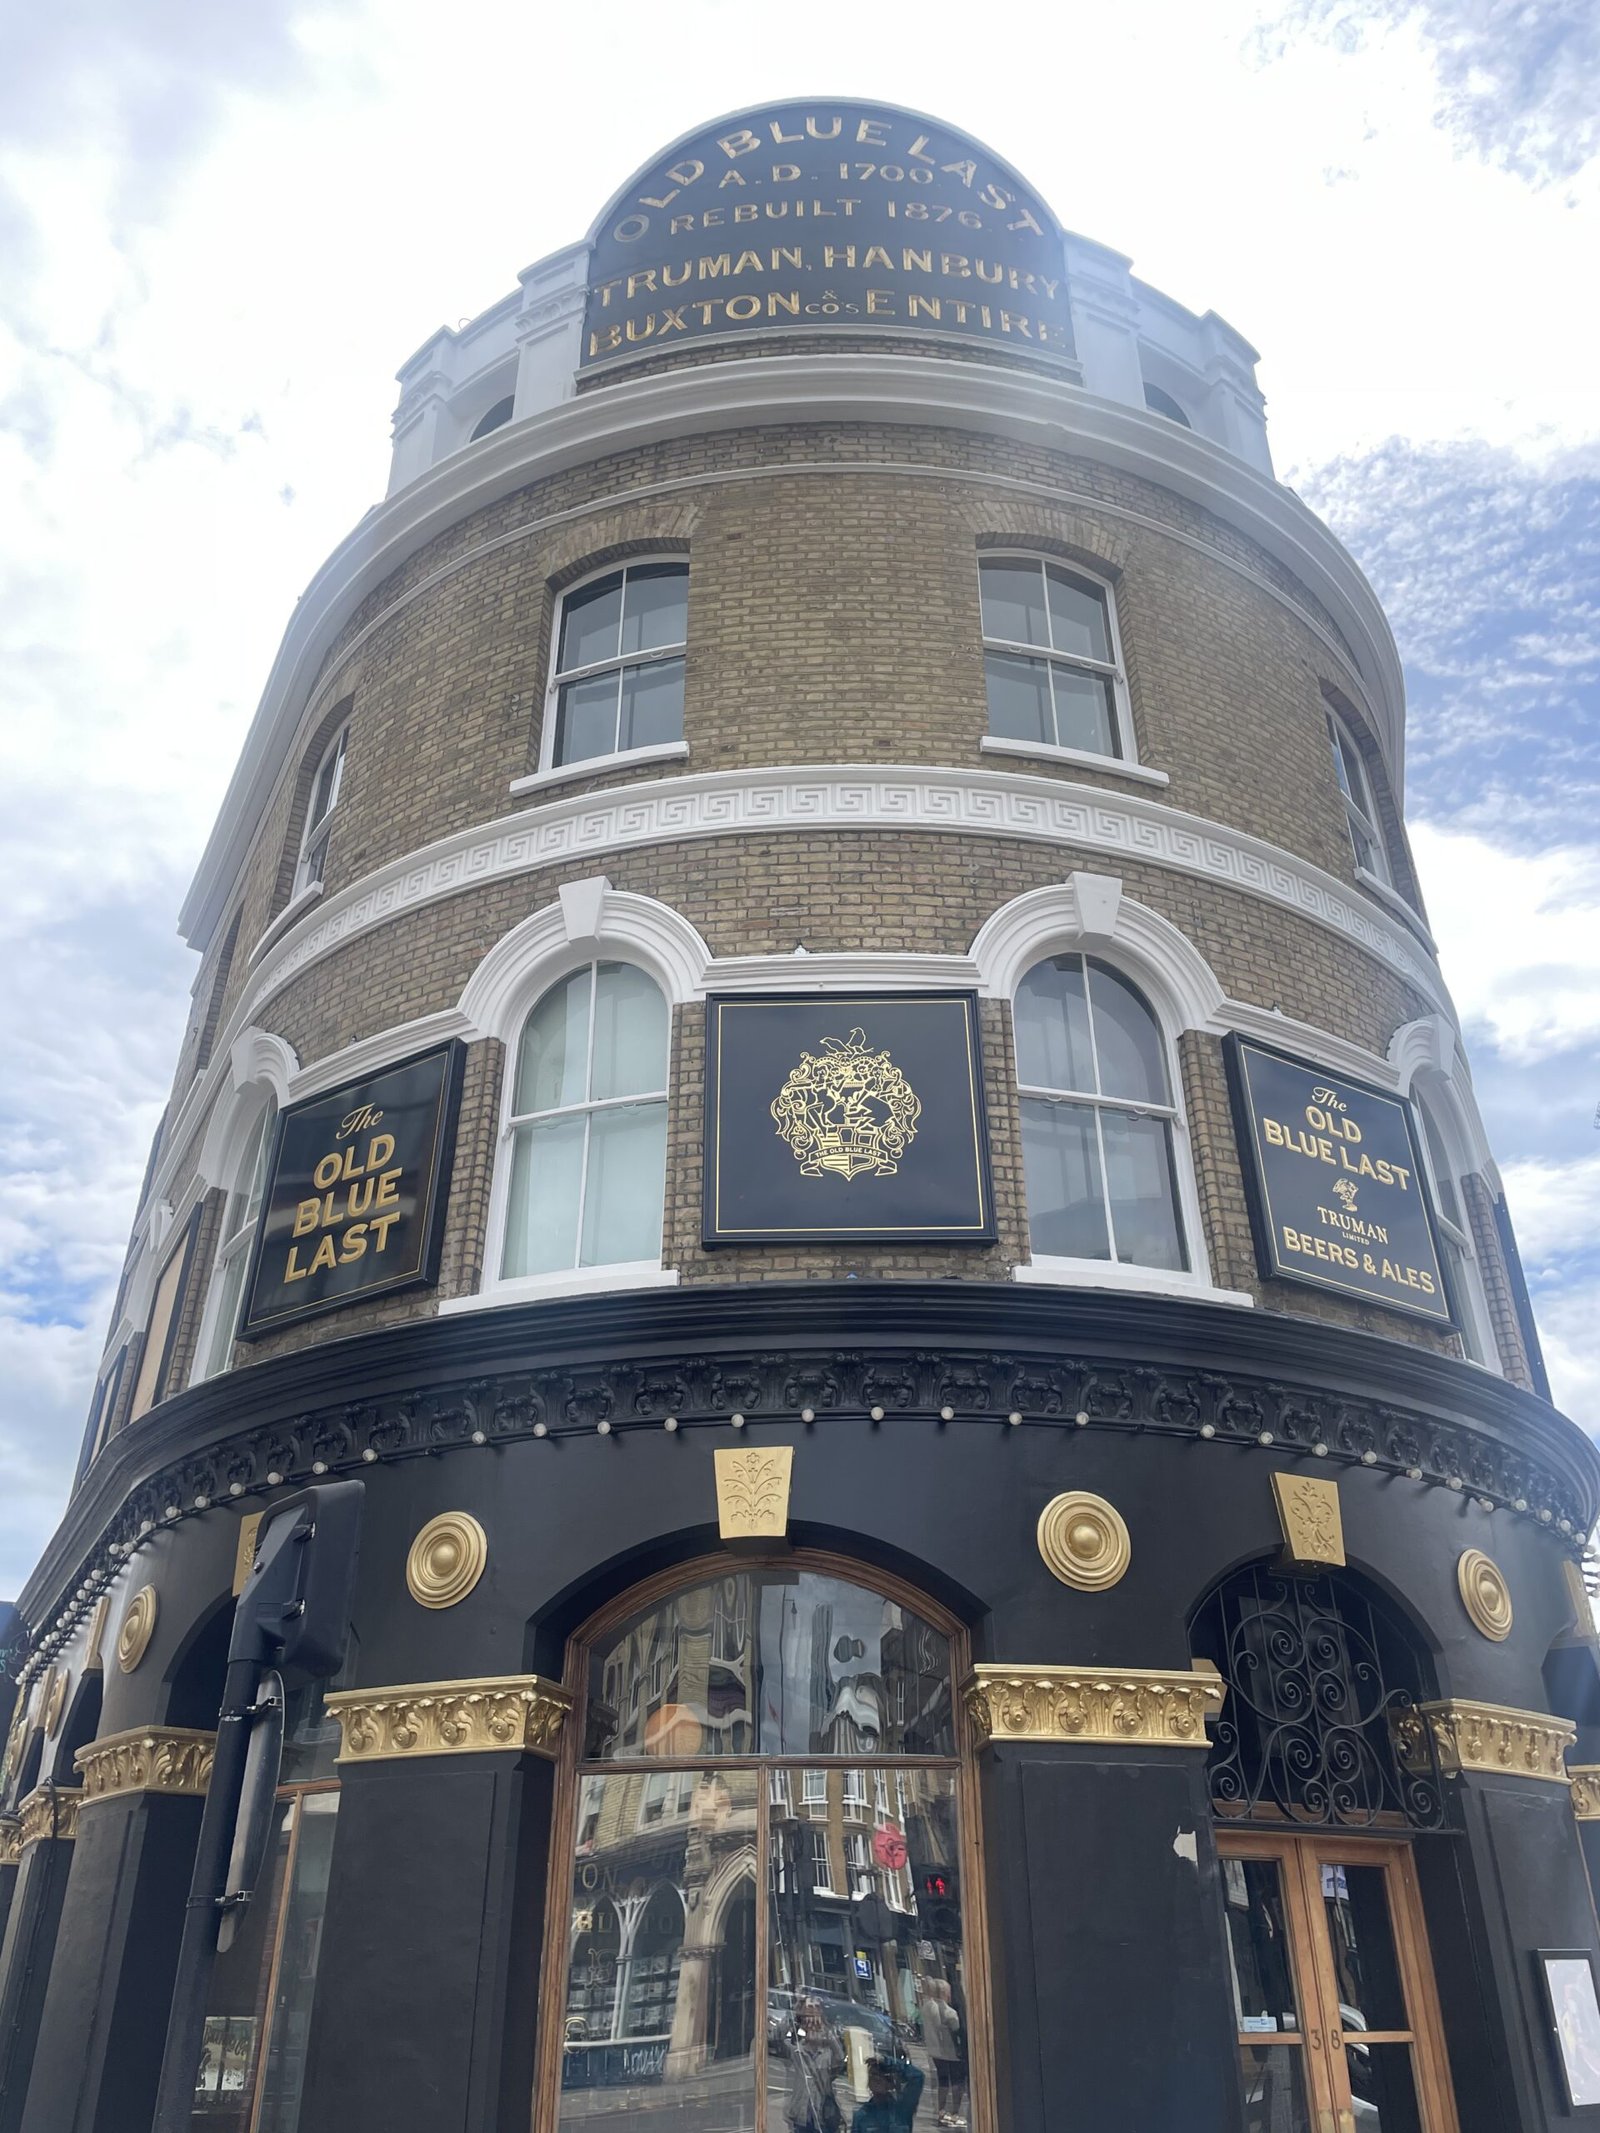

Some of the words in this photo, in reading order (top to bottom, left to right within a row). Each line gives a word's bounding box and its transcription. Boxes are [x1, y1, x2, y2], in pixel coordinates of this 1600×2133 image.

[613, 159, 704, 242] OLD
[716, 116, 892, 159] BLUE
[907, 135, 1044, 236] LAST
[670, 198, 861, 235] REBUILT
[824, 245, 1059, 300] HANBURY
[589, 290, 800, 357] BUXTON
[866, 289, 1066, 349] ENTIRE
[336, 1102, 384, 1140] The
[1305, 1105, 1362, 1143] OLD
[1311, 1086, 1347, 1112] The
[313, 1133, 395, 1190] OLD
[815, 1149, 829, 1158] THE
[863, 1148, 882, 1157] LAST
[1263, 1117, 1337, 1166] BLUE
[1339, 1146, 1410, 1191] LAST
[292, 1167, 403, 1238] BLUE
[1317, 1206, 1389, 1245] TRUMAN
[283, 1211, 401, 1284] LAST
[1282, 1226, 1359, 1270] BEERS
[1362, 1253, 1377, 1276] &
[1382, 1259, 1435, 1295] ALES
[1342, 1231, 1370, 1246] LIMITED
